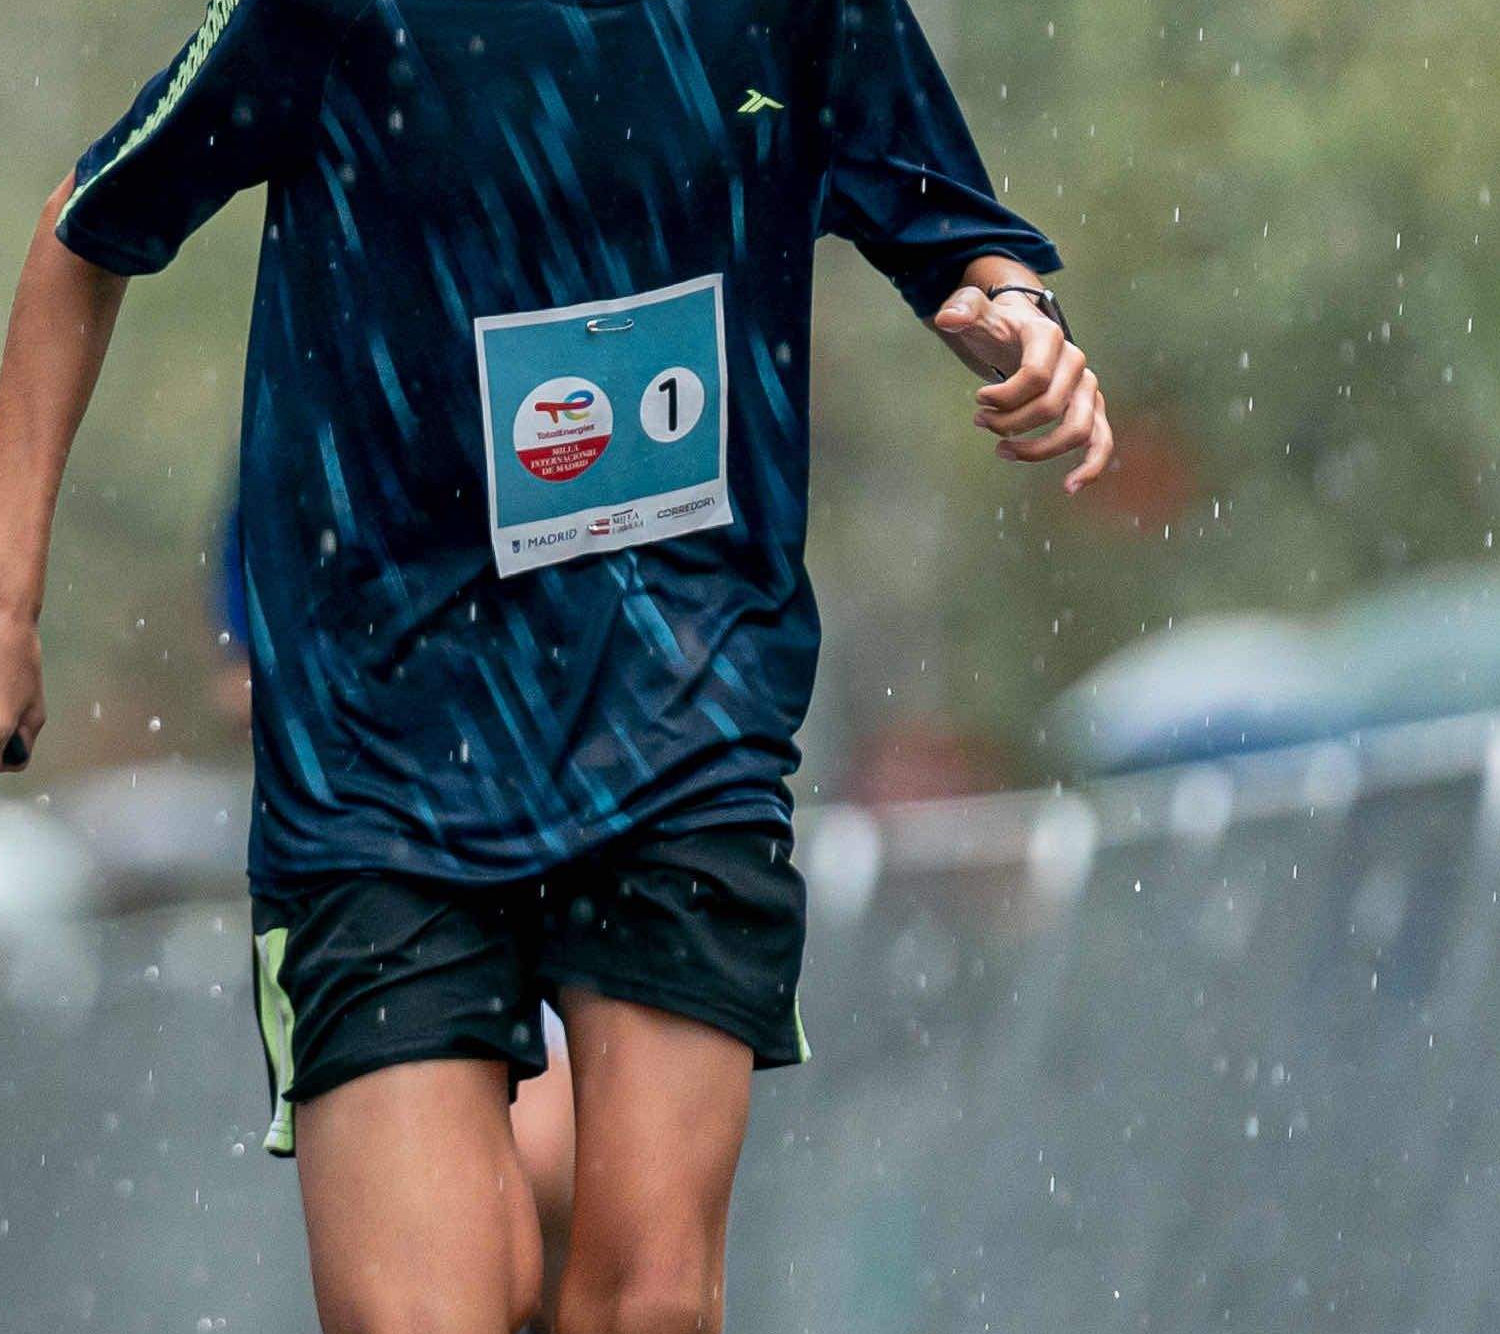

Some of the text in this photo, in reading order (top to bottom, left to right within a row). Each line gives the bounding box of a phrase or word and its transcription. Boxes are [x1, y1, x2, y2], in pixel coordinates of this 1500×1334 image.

[658, 377, 678, 432] 1
[536, 424, 595, 440] TotalEnergies
[527, 528, 578, 548] MADRID
